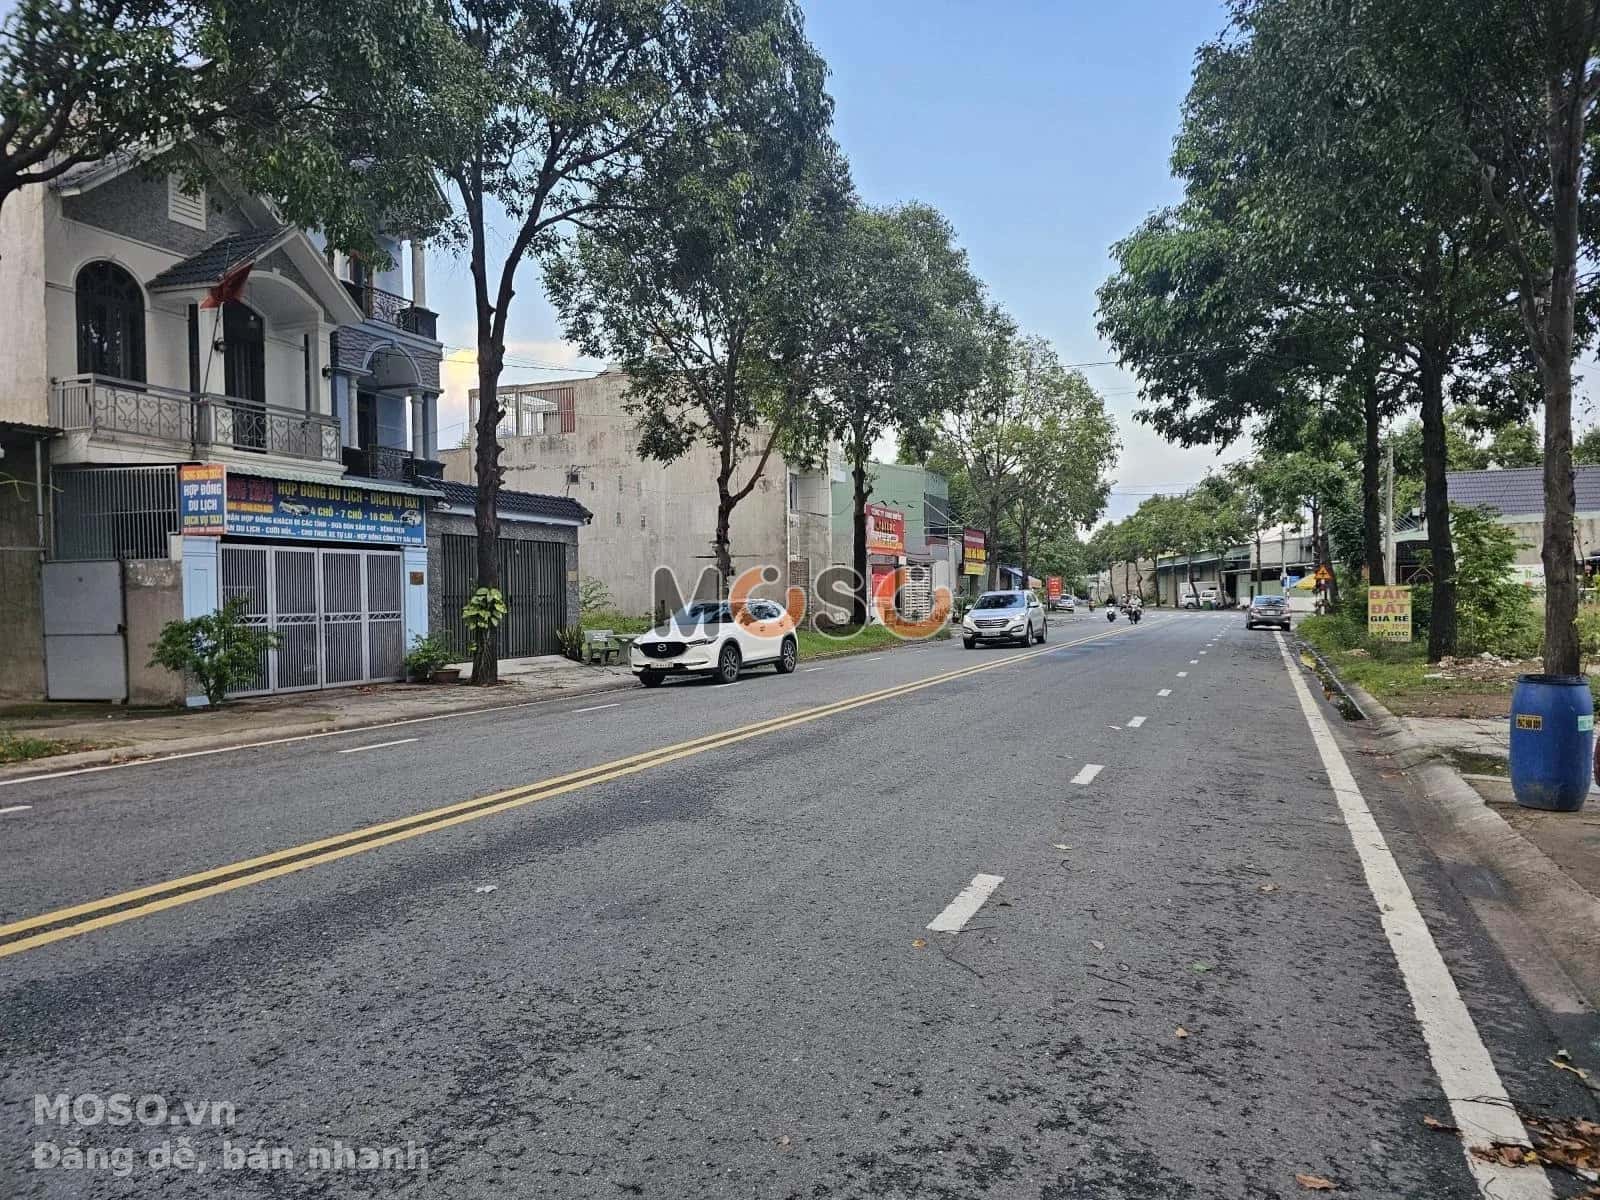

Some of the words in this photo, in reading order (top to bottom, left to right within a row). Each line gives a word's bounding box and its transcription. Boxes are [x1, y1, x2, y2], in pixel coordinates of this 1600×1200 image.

[188, 499, 199, 511] DU
[200, 499, 217, 513] LỊCH
[328, 487, 341, 500] DU
[343, 488, 363, 504] LỊCH
[370, 491, 390, 507] DỊCH
[404, 495, 420, 509] TAXI
